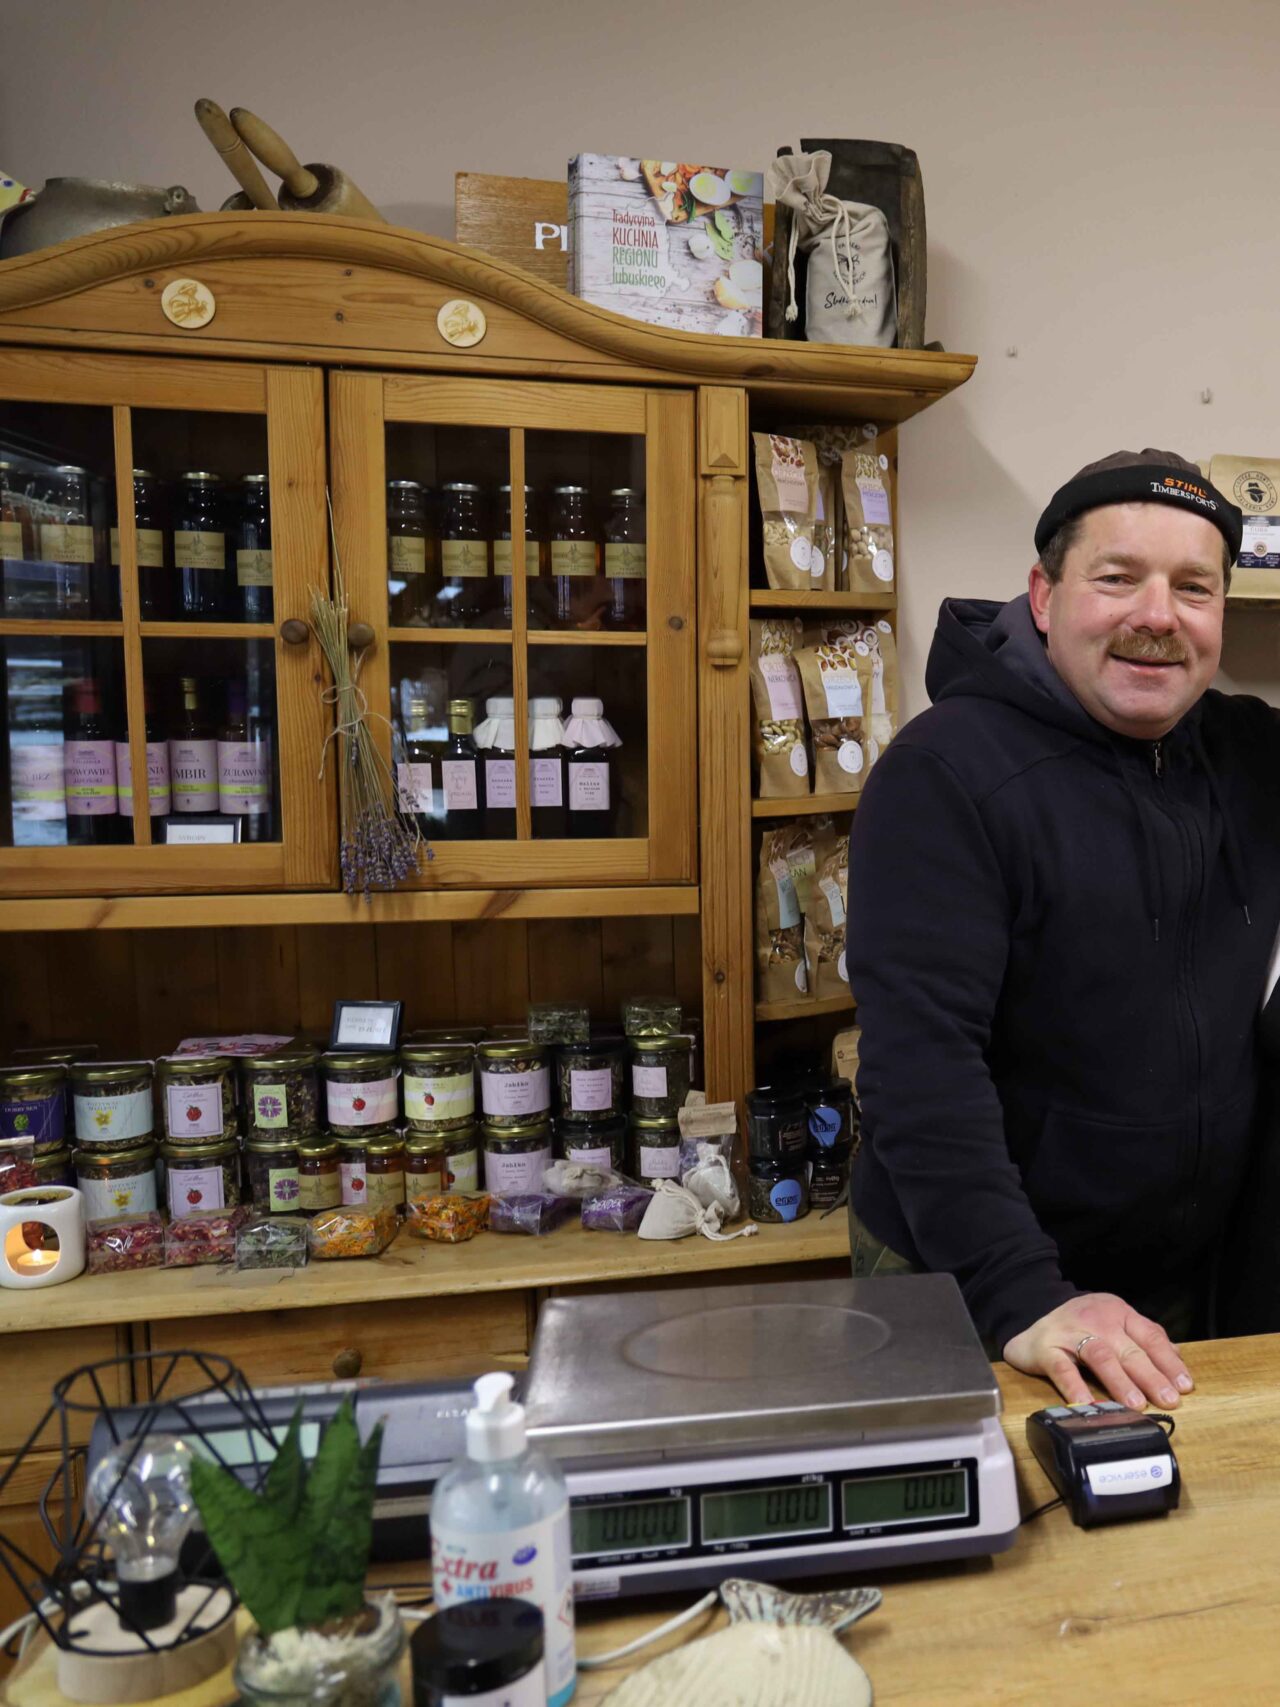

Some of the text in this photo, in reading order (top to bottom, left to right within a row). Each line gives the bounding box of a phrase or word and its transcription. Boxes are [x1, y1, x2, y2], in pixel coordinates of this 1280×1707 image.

[612, 208, 655, 227] Tradycyjna
[612, 226, 659, 249] KUCHNIA
[612, 246, 658, 269] REGIONU
[1163, 477, 1207, 499] STIHL
[669, 1486, 683, 1498] kg
